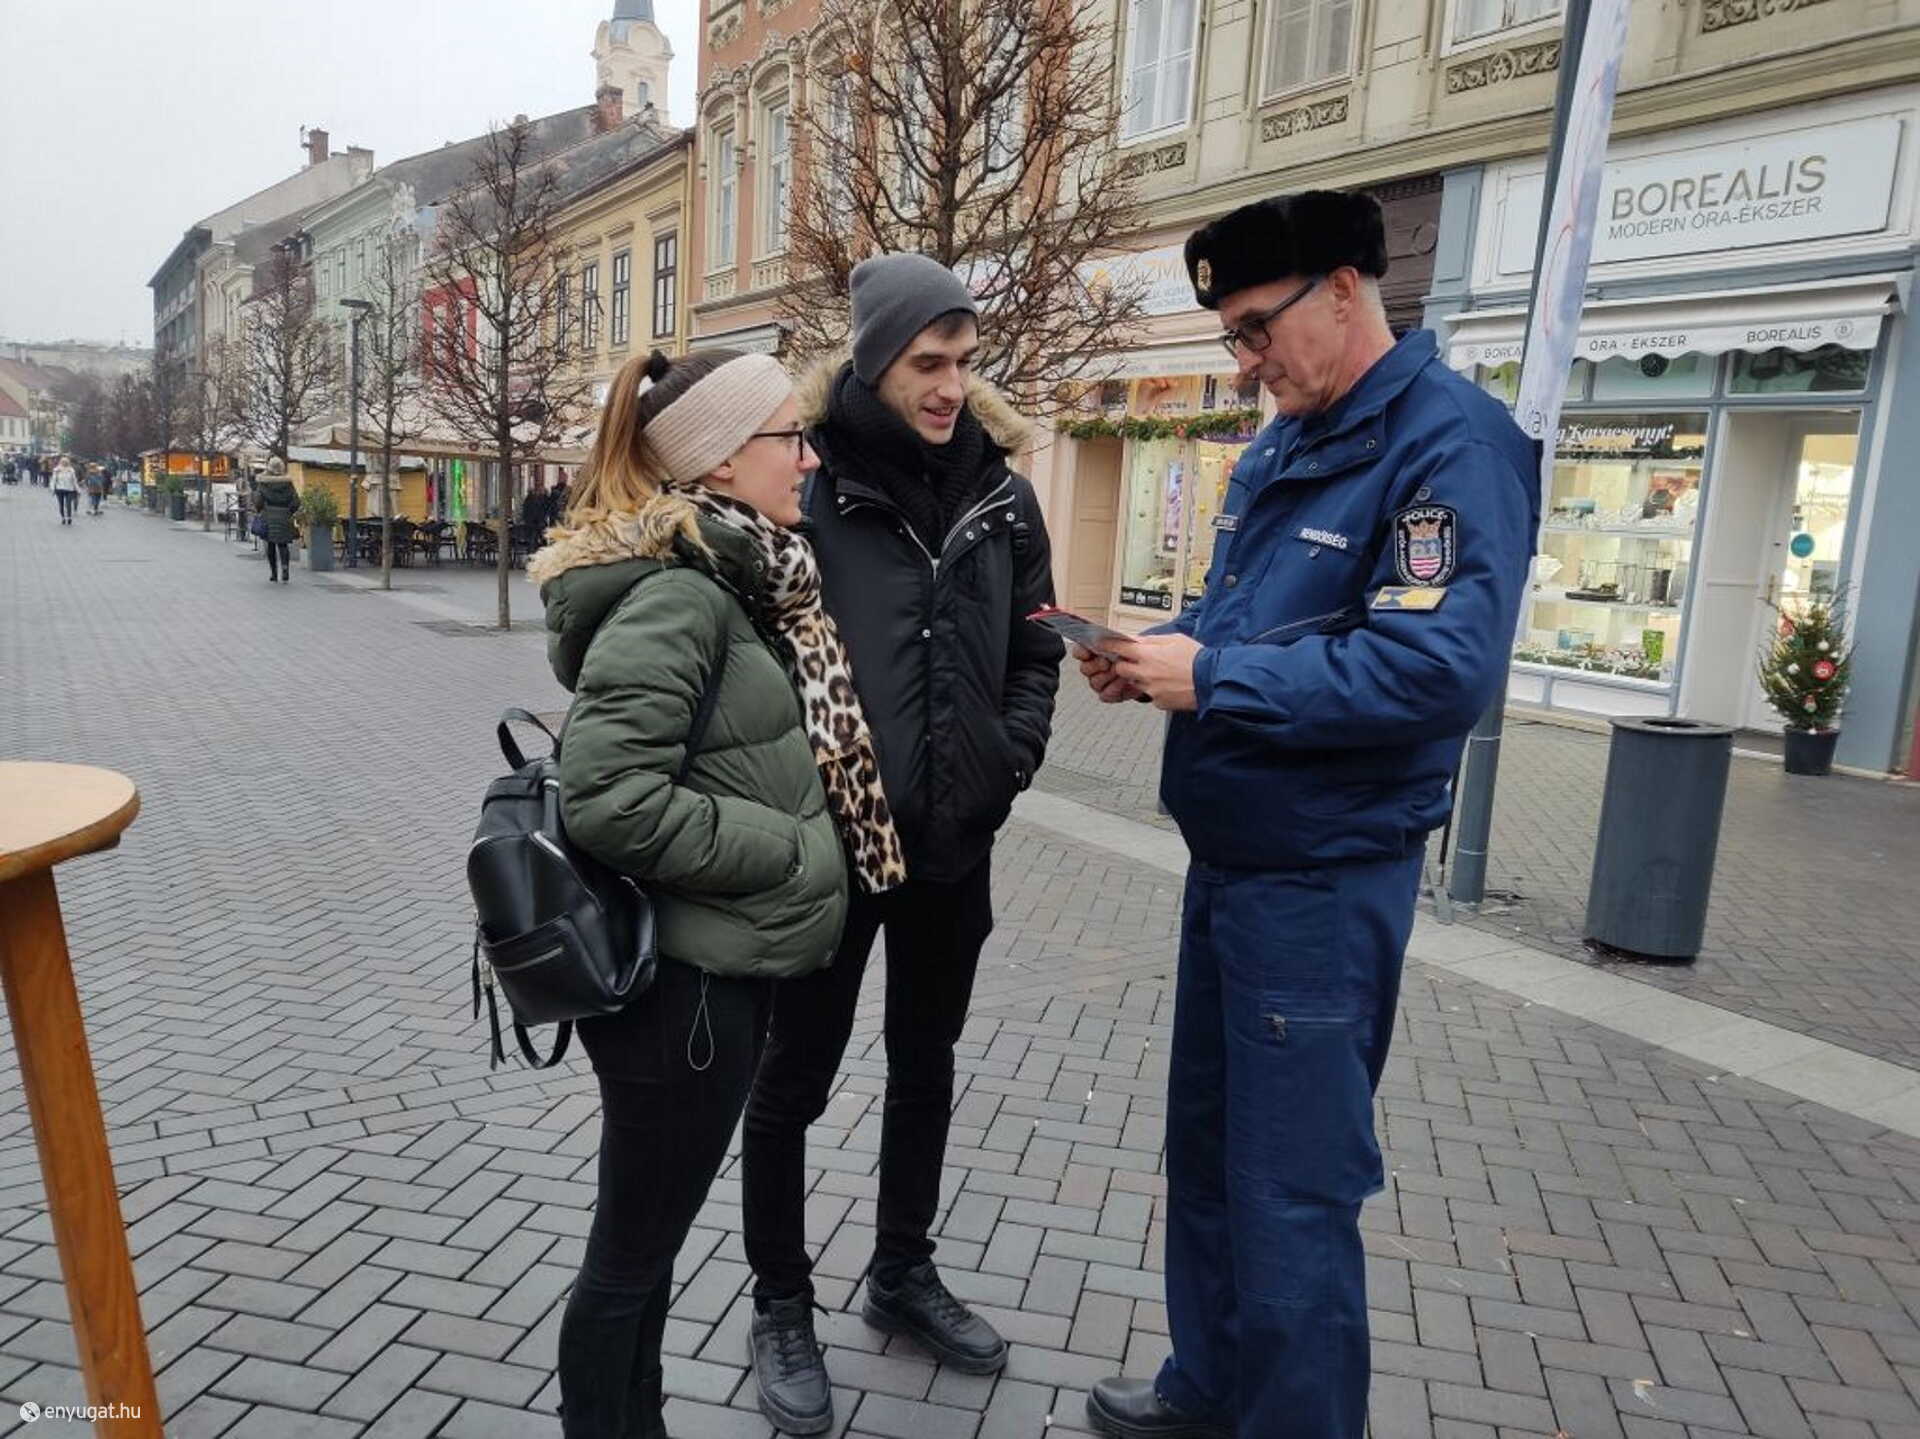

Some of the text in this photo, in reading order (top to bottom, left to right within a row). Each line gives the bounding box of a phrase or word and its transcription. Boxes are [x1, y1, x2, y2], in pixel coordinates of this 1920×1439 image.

[1612, 155, 1827, 220] BOREALIS
[1608, 216, 1686, 240] MODERN
[1746, 326, 1822, 343] BOREALIS
